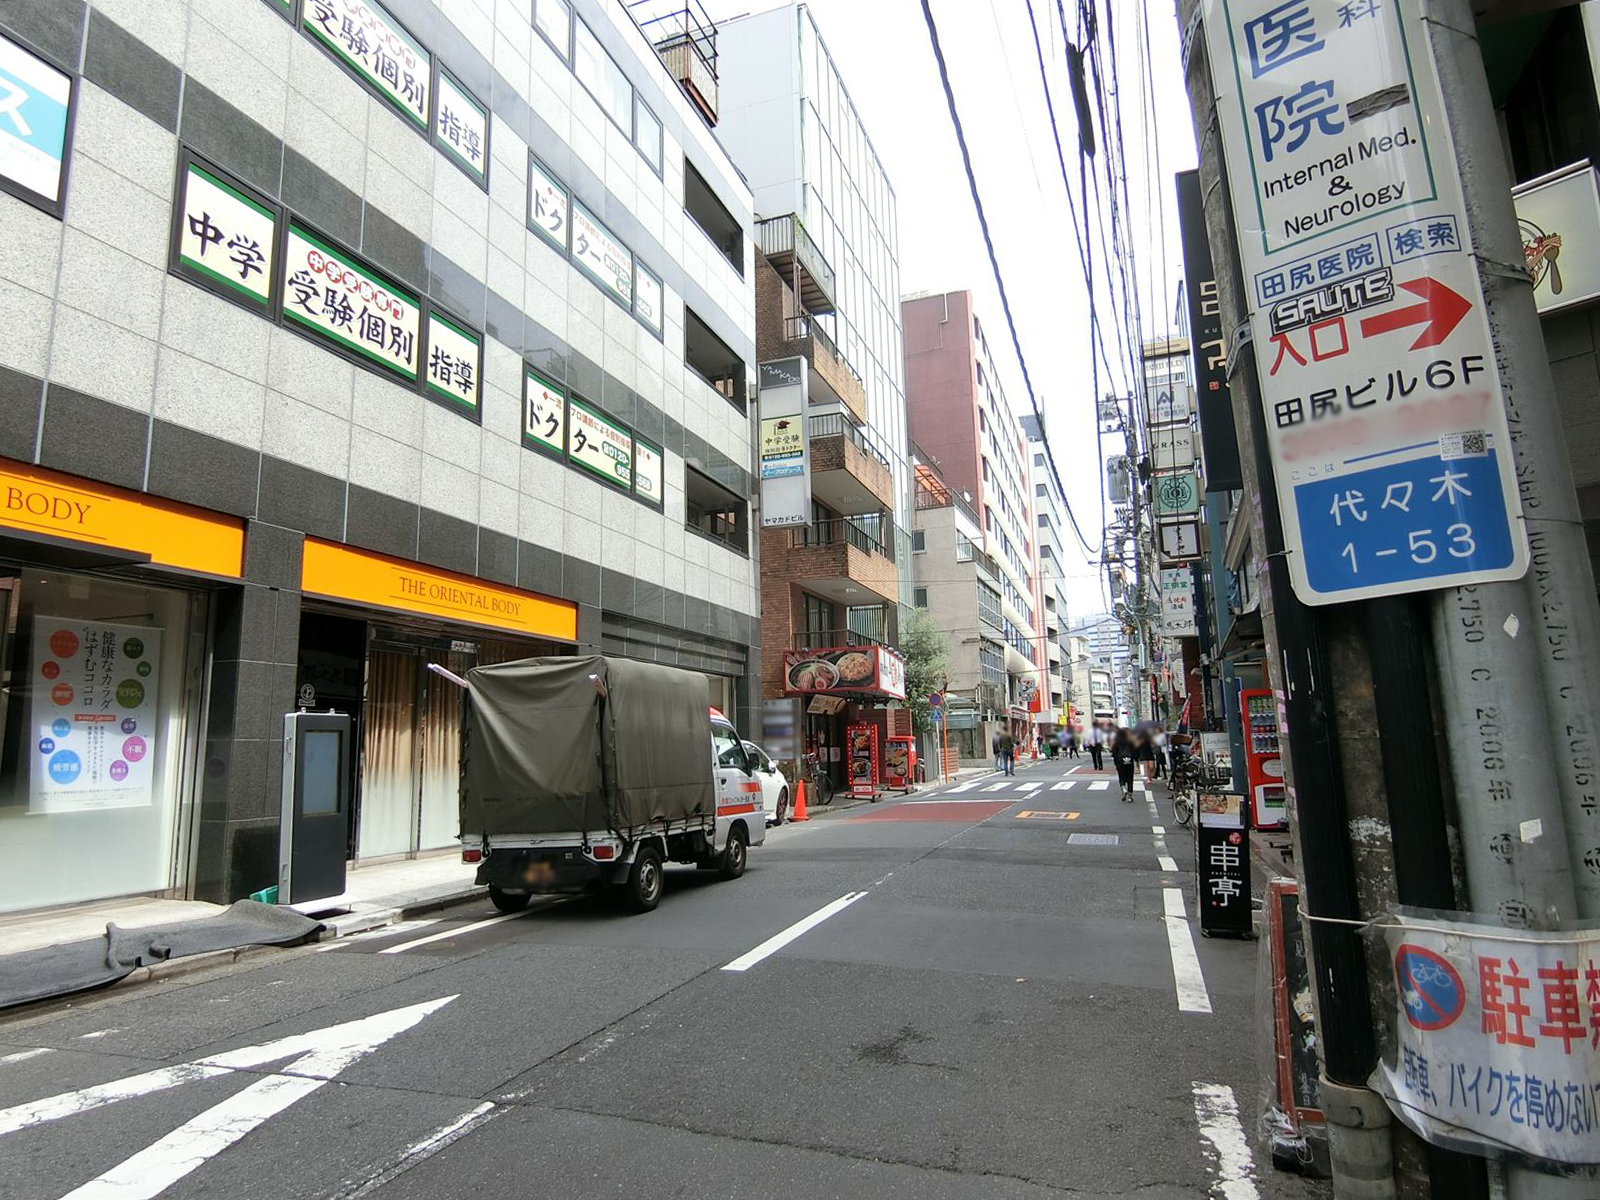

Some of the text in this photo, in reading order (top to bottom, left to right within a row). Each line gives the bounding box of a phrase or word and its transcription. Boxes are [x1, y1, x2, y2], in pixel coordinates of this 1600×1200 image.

[1336, 0, 1381, 29] 科
[310, 0, 426, 115] 受験個別
[439, 104, 481, 162] 指導
[1264, 128, 1417, 198] Internal Med.
[1328, 175, 1353, 196] &
[1284, 180, 1407, 239] Neurology
[1261, 222, 1456, 299] 田尻医院 検索
[187, 211, 475, 395] 中学 受験個別 指導
[1273, 271, 1392, 330] SAUTE
[1269, 316, 1350, 376] 入口
[1274, 354, 1485, 428] 田尻ビル6F
[1153, 439, 1189, 450] GRASS
[1291, 463, 1335, 481] ここは
[7, 486, 91, 525] BODY
[765, 514, 804, 525] ヤマカドビル
[1329, 470, 1472, 526] 代々木
[1341, 523, 1476, 574] 1-53
[400, 576, 521, 617] THE ORIENTAL BODY
[84, 630, 98, 706] はずむココロ
[101, 630, 116, 712] 健康なカラダ
